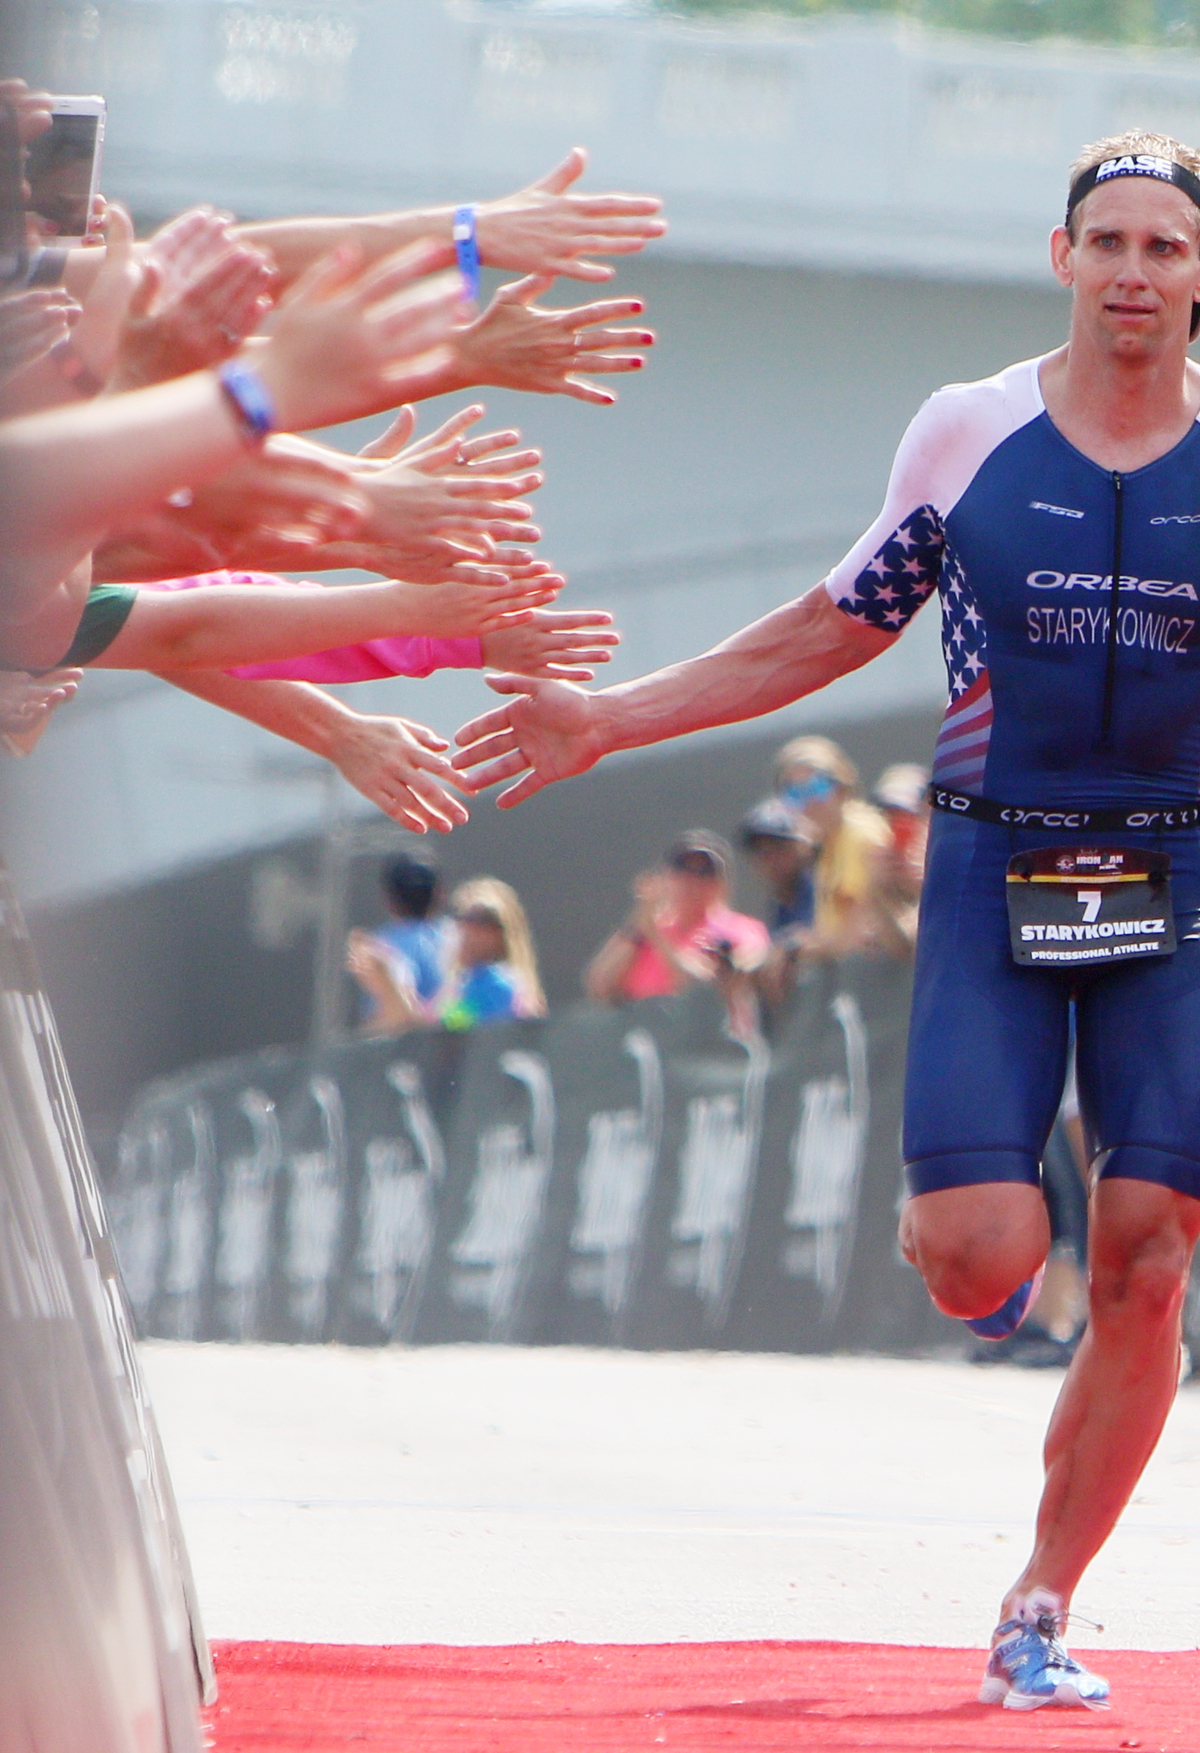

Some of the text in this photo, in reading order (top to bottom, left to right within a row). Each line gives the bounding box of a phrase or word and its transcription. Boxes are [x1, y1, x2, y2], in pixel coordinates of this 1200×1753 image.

[1096, 155, 1173, 178] BASE
[1026, 569, 1199, 601] ORBEA
[1026, 606, 1195, 654] STARYKOWICZ
[1077, 891, 1102, 923] 7
[1021, 918, 1165, 942] STARYKOWICZ
[1031, 941, 1159, 961] PROFESSIONAL ATHLETE
